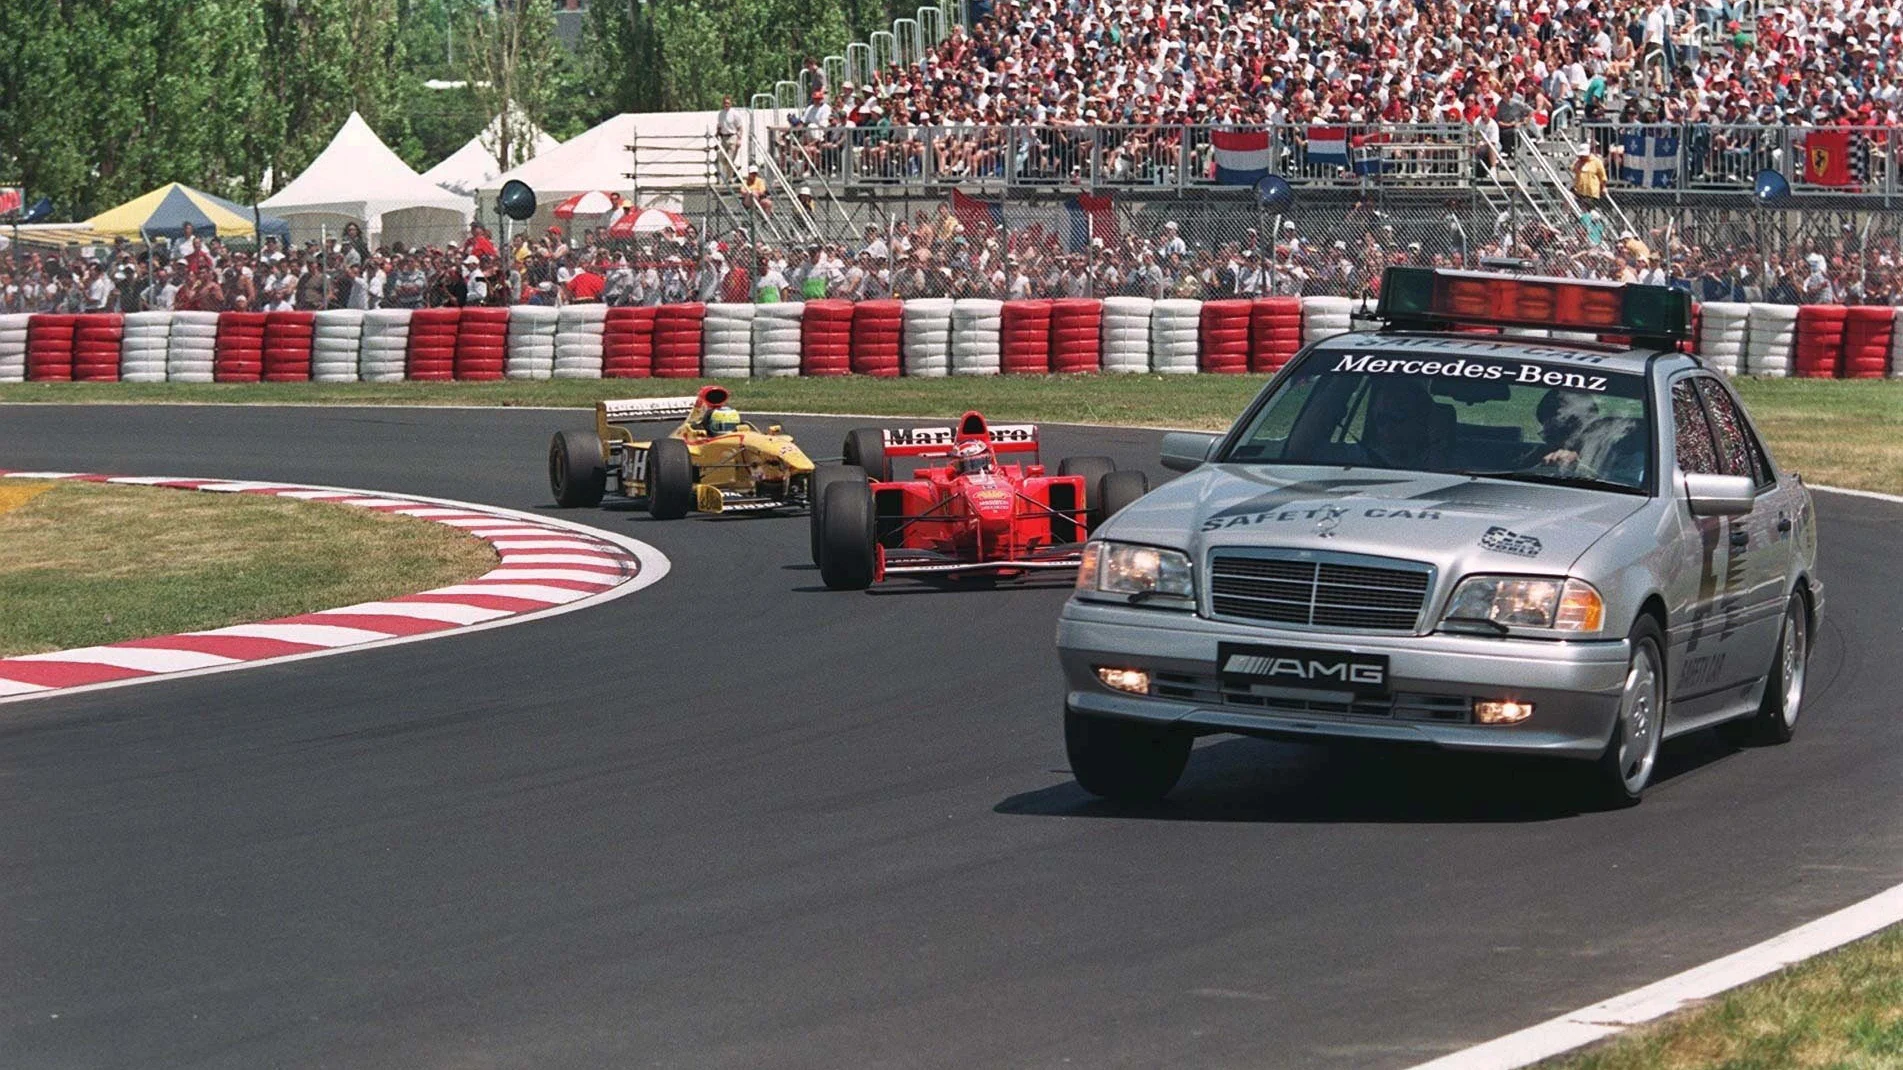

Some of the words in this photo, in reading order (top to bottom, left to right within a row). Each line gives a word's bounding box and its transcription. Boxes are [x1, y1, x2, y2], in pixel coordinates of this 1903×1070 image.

[1354, 337, 1510, 351] SAFETY
[1523, 347, 1610, 364] CAR
[1330, 353, 1608, 392] Mercedes-Benz
[889, 427, 1028, 445] Marro
[1200, 508, 1350, 532] SAFETY
[1364, 508, 1442, 520] CAR
[1268, 657, 1384, 684] AMG
